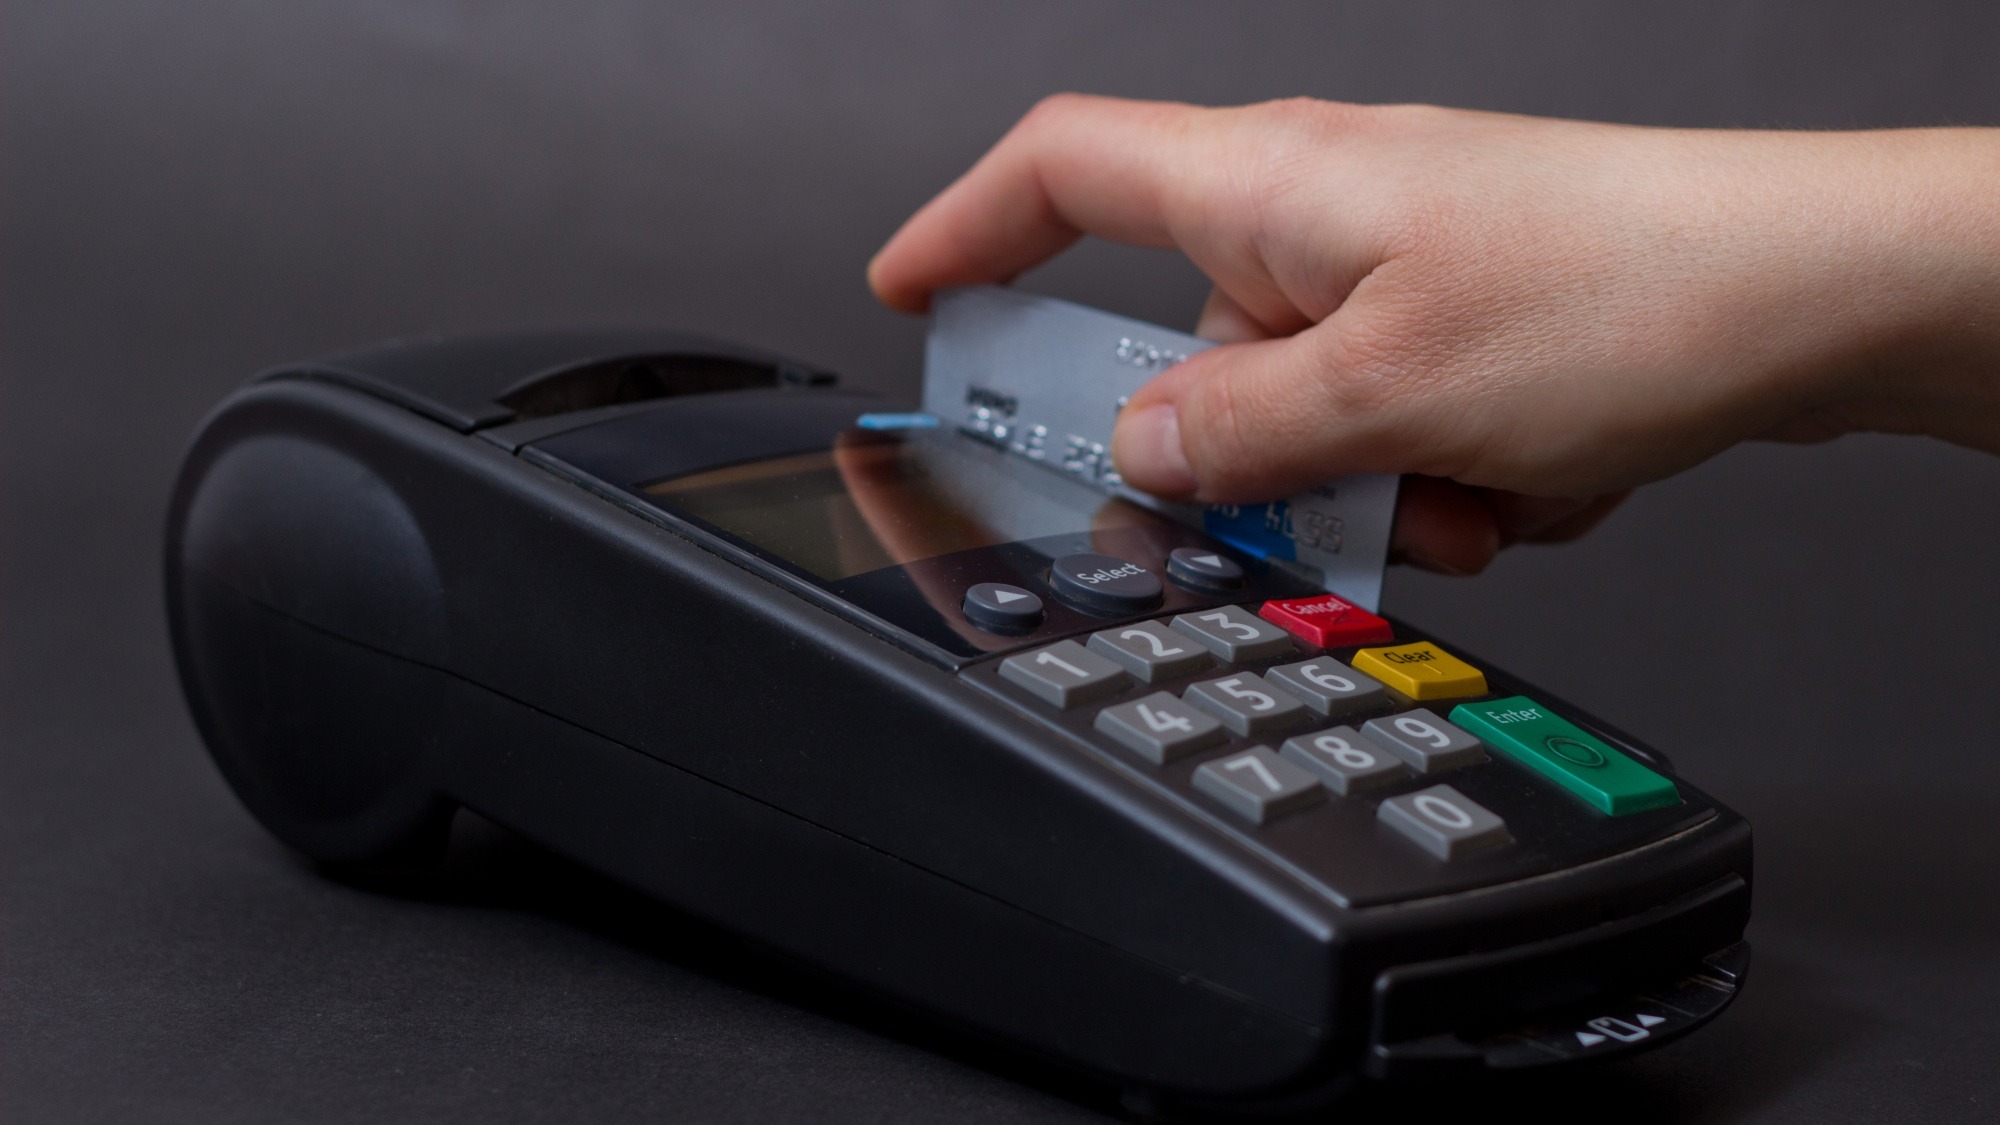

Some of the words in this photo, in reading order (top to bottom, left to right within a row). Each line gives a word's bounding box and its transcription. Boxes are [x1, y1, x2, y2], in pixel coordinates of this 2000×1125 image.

[1077, 563, 1146, 584] Select
[1282, 597, 1351, 615] Cancel
[1035, 650, 1091, 678] 1
[1120, 630, 1183, 657] 2
[1199, 612, 1260, 640] 3
[1382, 649, 1436, 665] Clear
[1136, 703, 1194, 733] 4
[1215, 679, 1276, 709] 5
[1301, 664, 1356, 692] 6
[1486, 708, 1543, 725] Enter
[1225, 756, 1282, 791] 7
[1313, 735, 1376, 768] 8
[1394, 718, 1451, 747] 9
[1413, 795, 1473, 828] 0
